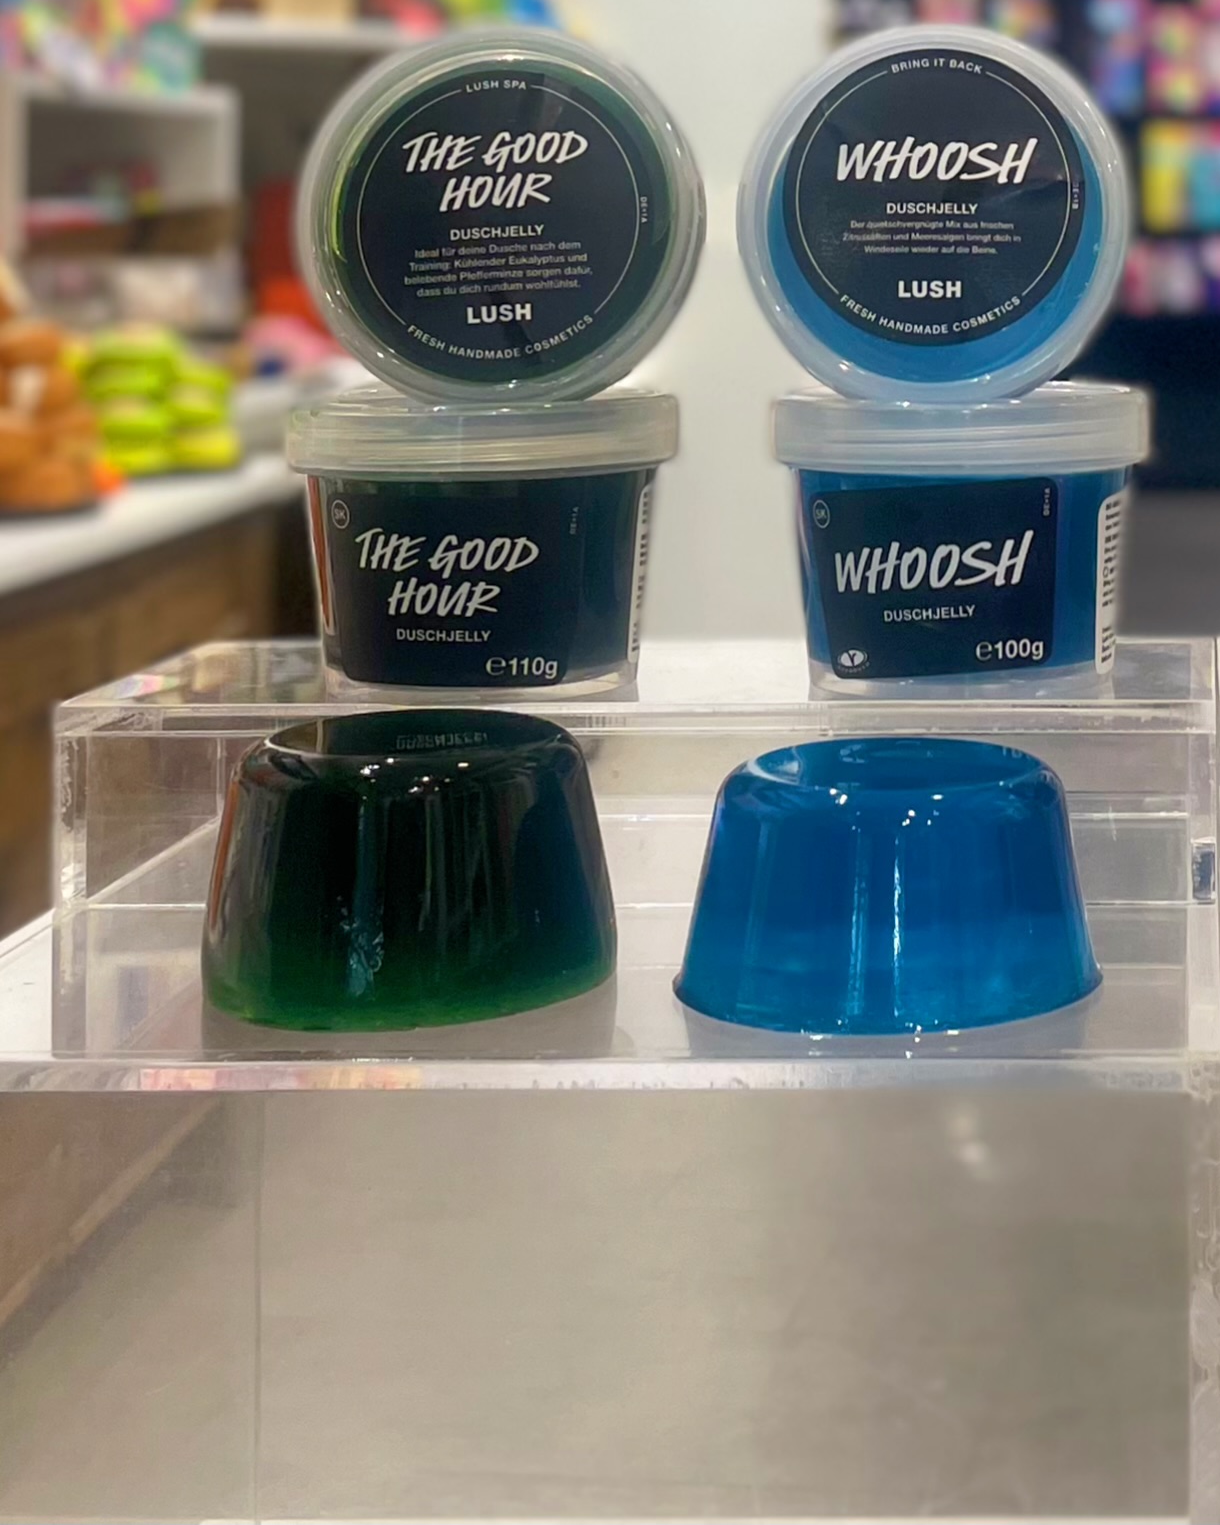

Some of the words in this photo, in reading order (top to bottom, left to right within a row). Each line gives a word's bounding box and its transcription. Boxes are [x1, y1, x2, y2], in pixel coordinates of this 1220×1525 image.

[891, 58, 930, 74] BRING
[933, 57, 946, 68] IT
[949, 59, 983, 74] BACK
[466, 80, 499, 93] LUSH
[503, 79, 527, 90] SPA
[403, 132, 482, 173] THE
[481, 130, 588, 172] GOOD
[836, 136, 1038, 185] WHOOSH
[439, 172, 552, 212] HOUR
[886, 202, 978, 215] DUSCHJELLY
[450, 224, 544, 241] DUSCHJELLY
[850, 220, 865, 229] Der
[945, 221, 961, 229] Mix
[893, 233, 909, 241] und
[993, 234, 1012, 242] dich
[1013, 234, 1021, 242] in
[415, 249, 440, 258] Ideal
[442, 247, 456, 257] für
[458, 246, 486, 256] deine
[489, 244, 528, 254] Dusche
[530, 242, 555, 251] nach
[557, 241, 581, 250] dem
[911, 245, 939, 254] wieder
[941, 245, 955, 254] auf
[957, 245, 970, 254] die
[454, 257, 506, 269] Kühlender
[508, 255, 565, 266] Eukalyptus
[568, 253, 588, 262] und
[404, 274, 458, 285] belebende
[526, 268, 562, 278] sorgen
[416, 287, 441, 297] dass
[443, 286, 457, 295] du
[459, 285, 482, 294] dich
[483, 283, 523, 292] rundum
[898, 280, 962, 298] LUSH
[467, 303, 532, 324] LUSH
[840, 294, 877, 322] FRESH
[878, 315, 949, 335] HANDMADE
[953, 295, 1021, 332] COSMETICS
[407, 324, 446, 352] FRESH
[448, 345, 522, 359] HANDMADE
[525, 314, 594, 355] COSMETICS
[334, 509, 346, 520] SK
[355, 527, 427, 572] THE
[428, 533, 539, 579] GOOD
[834, 529, 1034, 595] WHOOSH
[387, 577, 501, 617] HOUR
[883, 604, 975, 623] DUSCHJELLY
[396, 628, 491, 643] DUSCHJELLY
